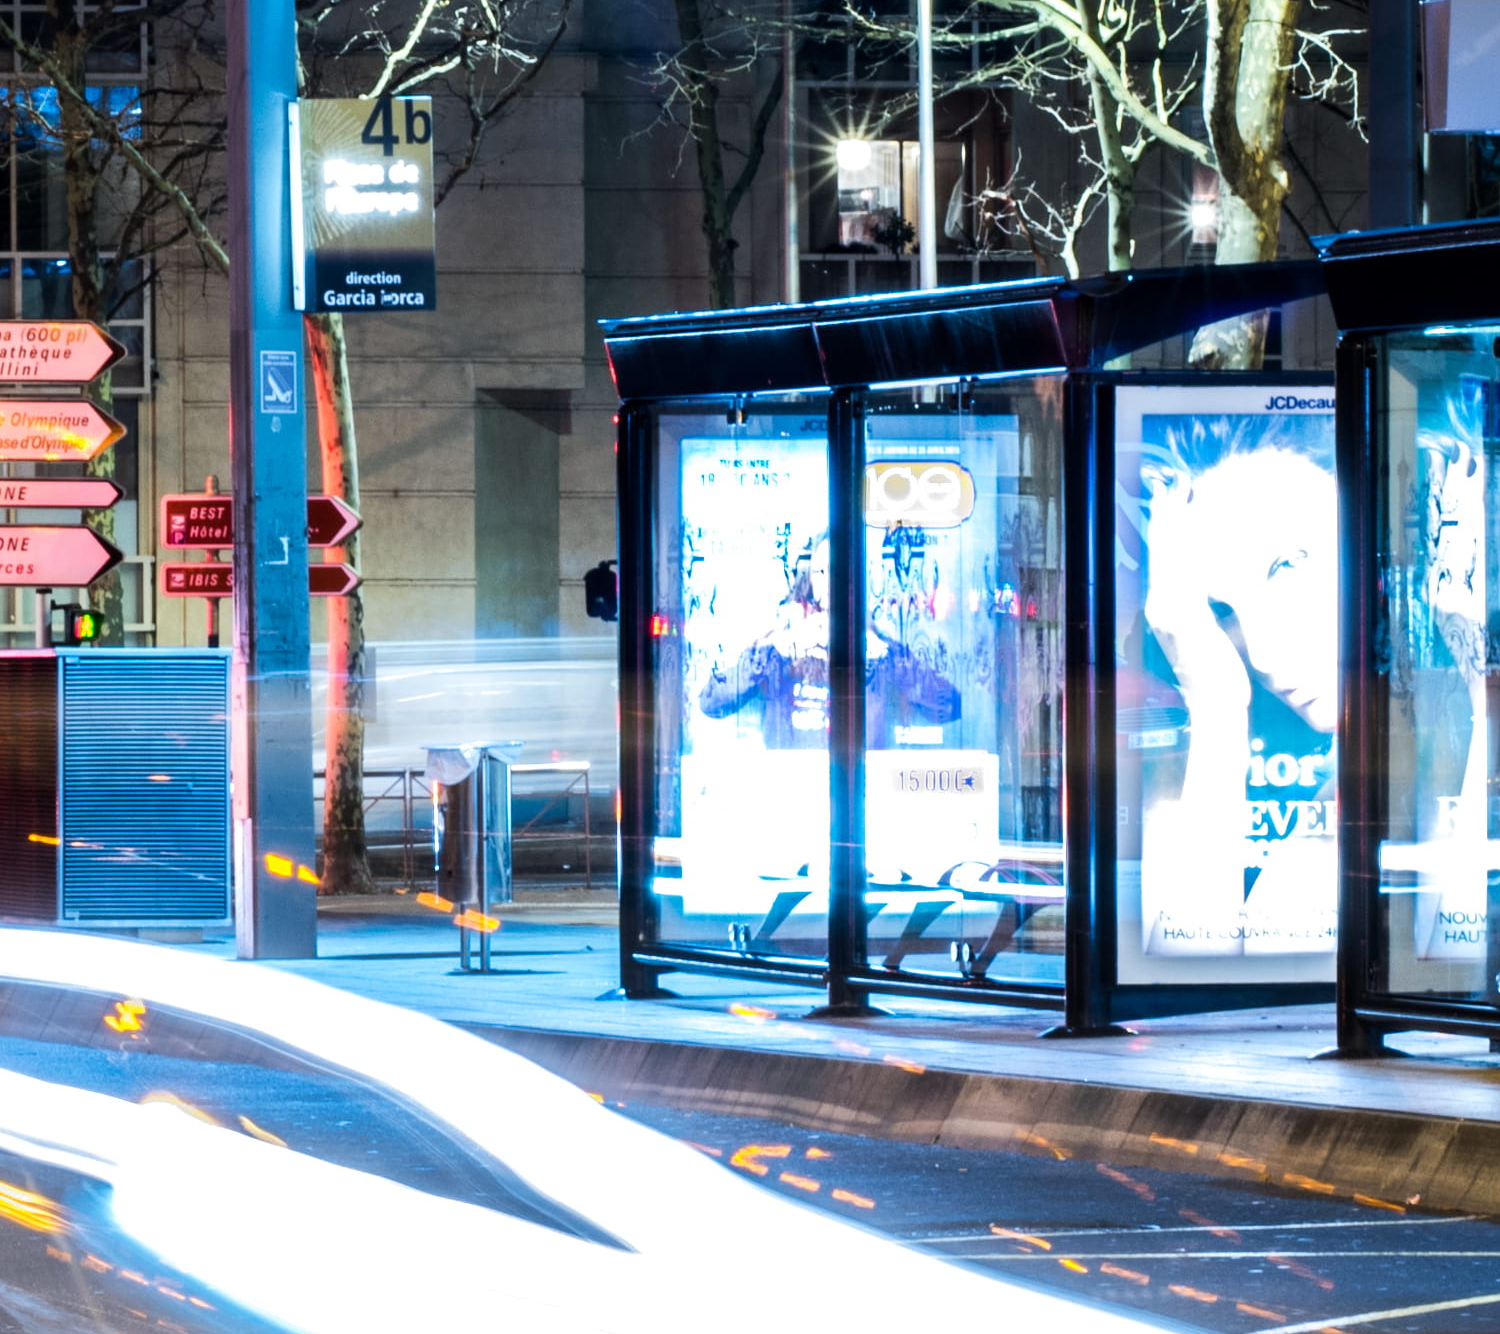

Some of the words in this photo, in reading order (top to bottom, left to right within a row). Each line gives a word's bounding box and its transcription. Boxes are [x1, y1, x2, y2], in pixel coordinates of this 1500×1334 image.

[361, 93, 433, 156] 4b
[346, 272, 401, 285] direction
[324, 289, 376, 306] Garcia
[1265, 396, 1336, 410] JCDecau
[10, 412, 89, 428] Olympique
[190, 507, 225, 520] BEST
[190, 525, 228, 538] Hôtel
[189, 574, 218, 587] IBIS
[1249, 737, 1324, 787] ior
